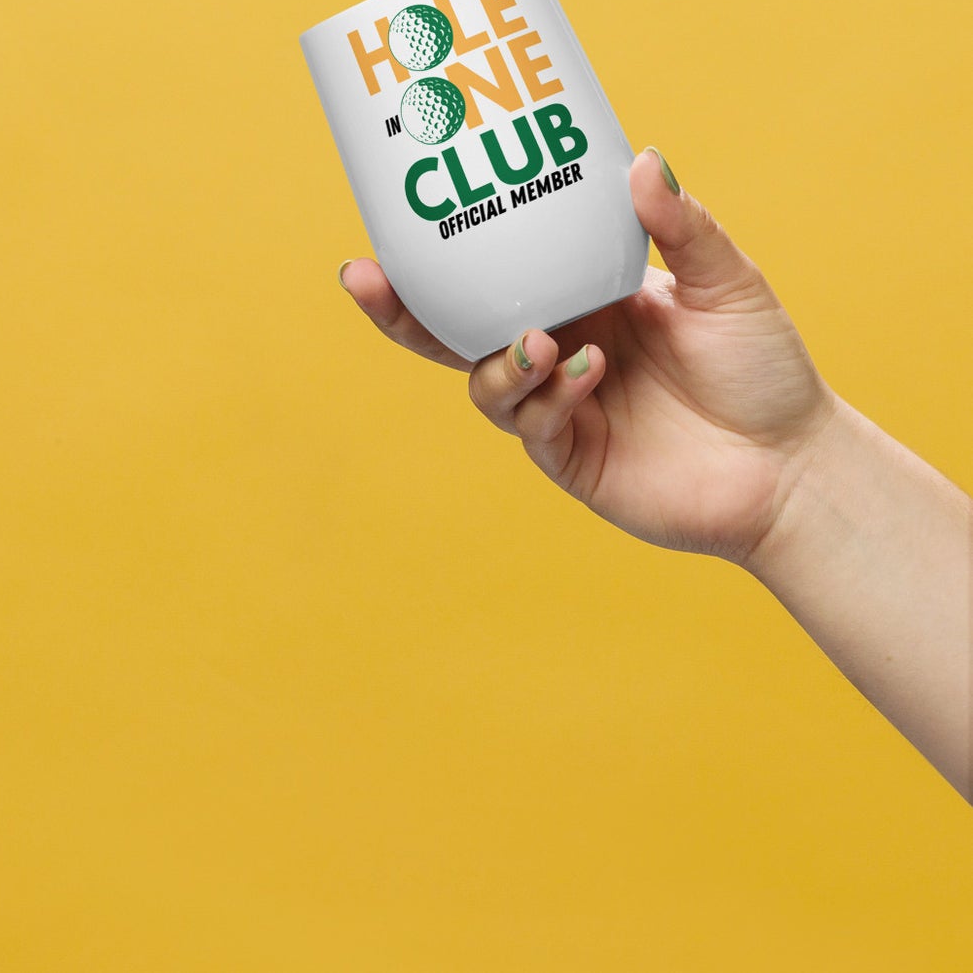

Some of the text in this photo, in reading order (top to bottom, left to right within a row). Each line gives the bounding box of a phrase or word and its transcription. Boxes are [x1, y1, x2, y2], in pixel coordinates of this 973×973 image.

[384, 31, 565, 145] IN ONE
[404, 102, 589, 222] CLUB
[438, 163, 583, 240] OFFICIAL MEMBER
